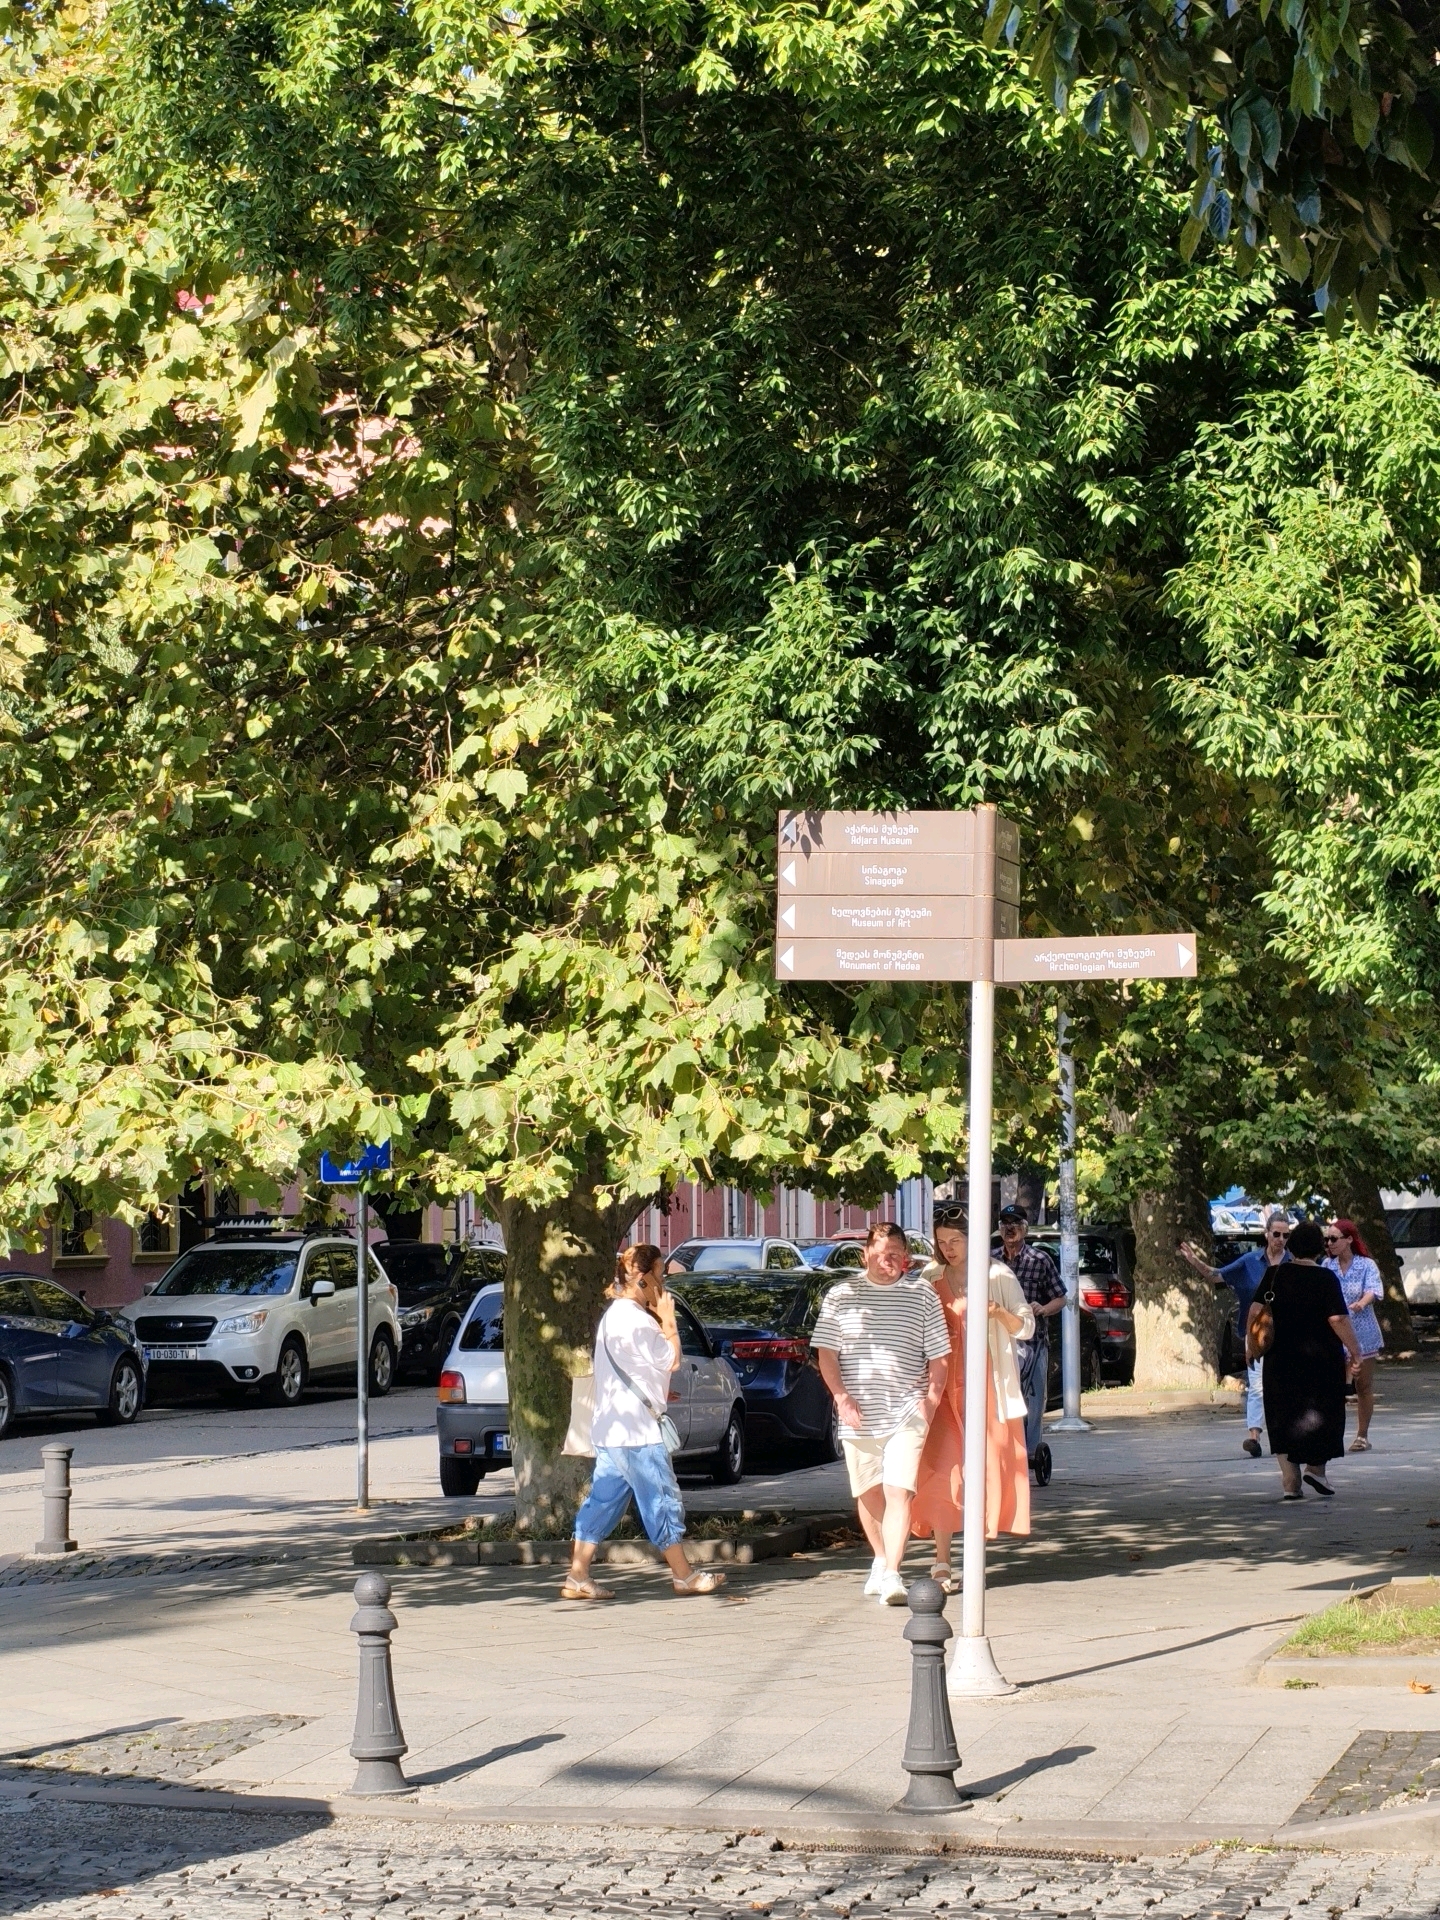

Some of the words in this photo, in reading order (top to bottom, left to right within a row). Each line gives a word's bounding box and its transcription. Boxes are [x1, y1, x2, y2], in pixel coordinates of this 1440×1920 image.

[844, 824, 879, 835] აჭარის
[882, 824, 919, 834] მუზეუმი
[851, 836, 878, 846] Adjara
[880, 836, 912, 845] Museum
[862, 865, 907, 876] სინაგოგა
[832, 907, 892, 918] ხელოვნების
[894, 908, 932, 918] მუზეუმი
[852, 918, 884, 928] Museum
[886, 918, 895, 928] of
[898, 919, 911, 928] Art
[836, 949, 870, 960] მედეას
[873, 950, 924, 961] მონუმენტი
[1034, 949, 1114, 962] არქეოლოგიური
[1117, 948, 1156, 959] მუზეუმი
[840, 960, 880, 970] Monument
[884, 962, 892, 970] of
[895, 962, 920, 971] Medea
[1050, 962, 1105, 973] Archeologian
[1108, 960, 1140, 969] Museum
